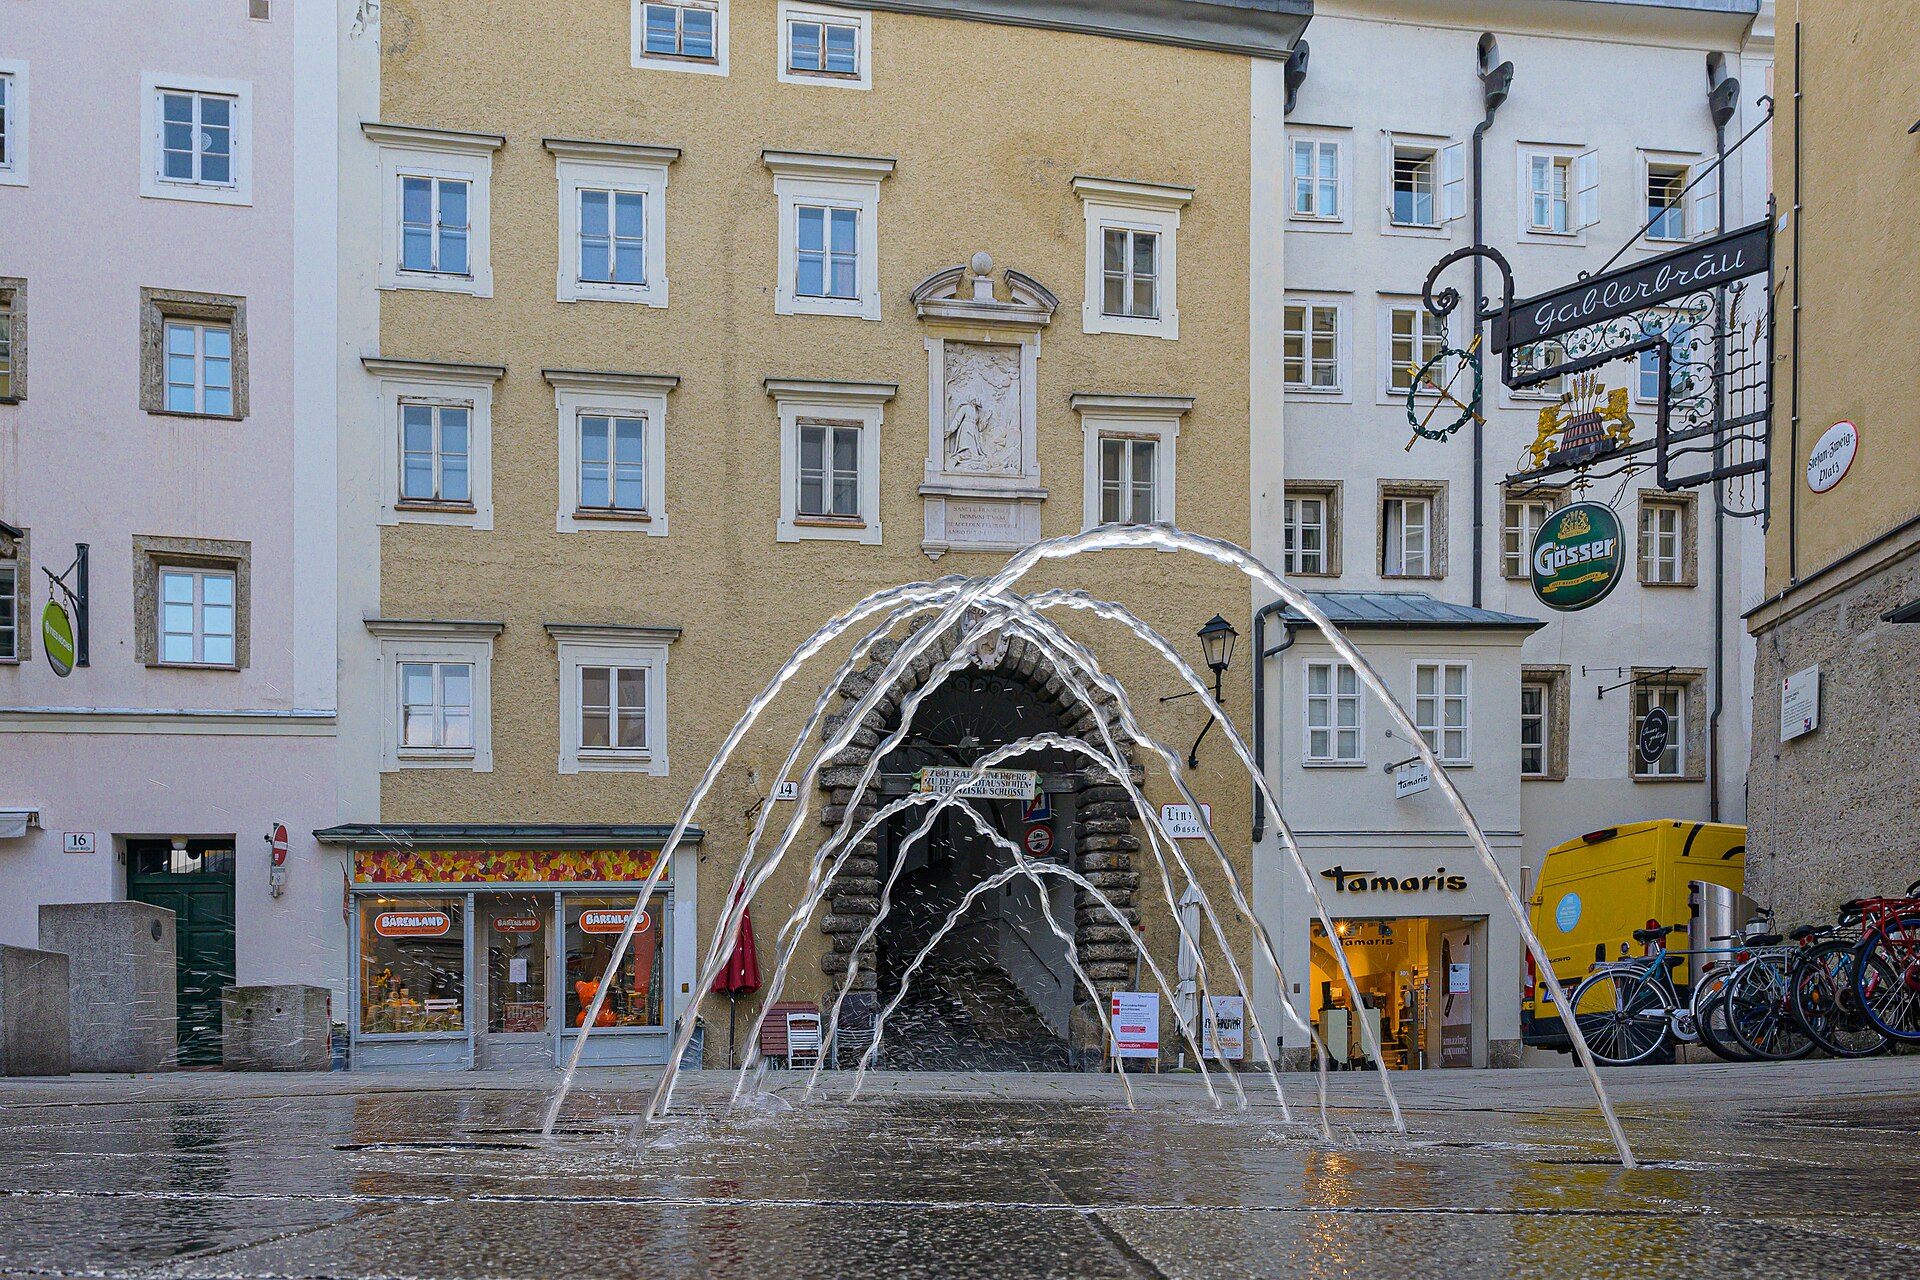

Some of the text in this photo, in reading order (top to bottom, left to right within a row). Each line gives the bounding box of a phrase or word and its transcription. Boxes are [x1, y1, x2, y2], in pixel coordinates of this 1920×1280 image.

[1818, 461, 1840, 487] Platz
[1534, 537, 1616, 578] Gösser
[780, 782, 793, 795] 14
[72, 833, 87, 846] 16
[381, 914, 444, 928] BÄRENLAND
